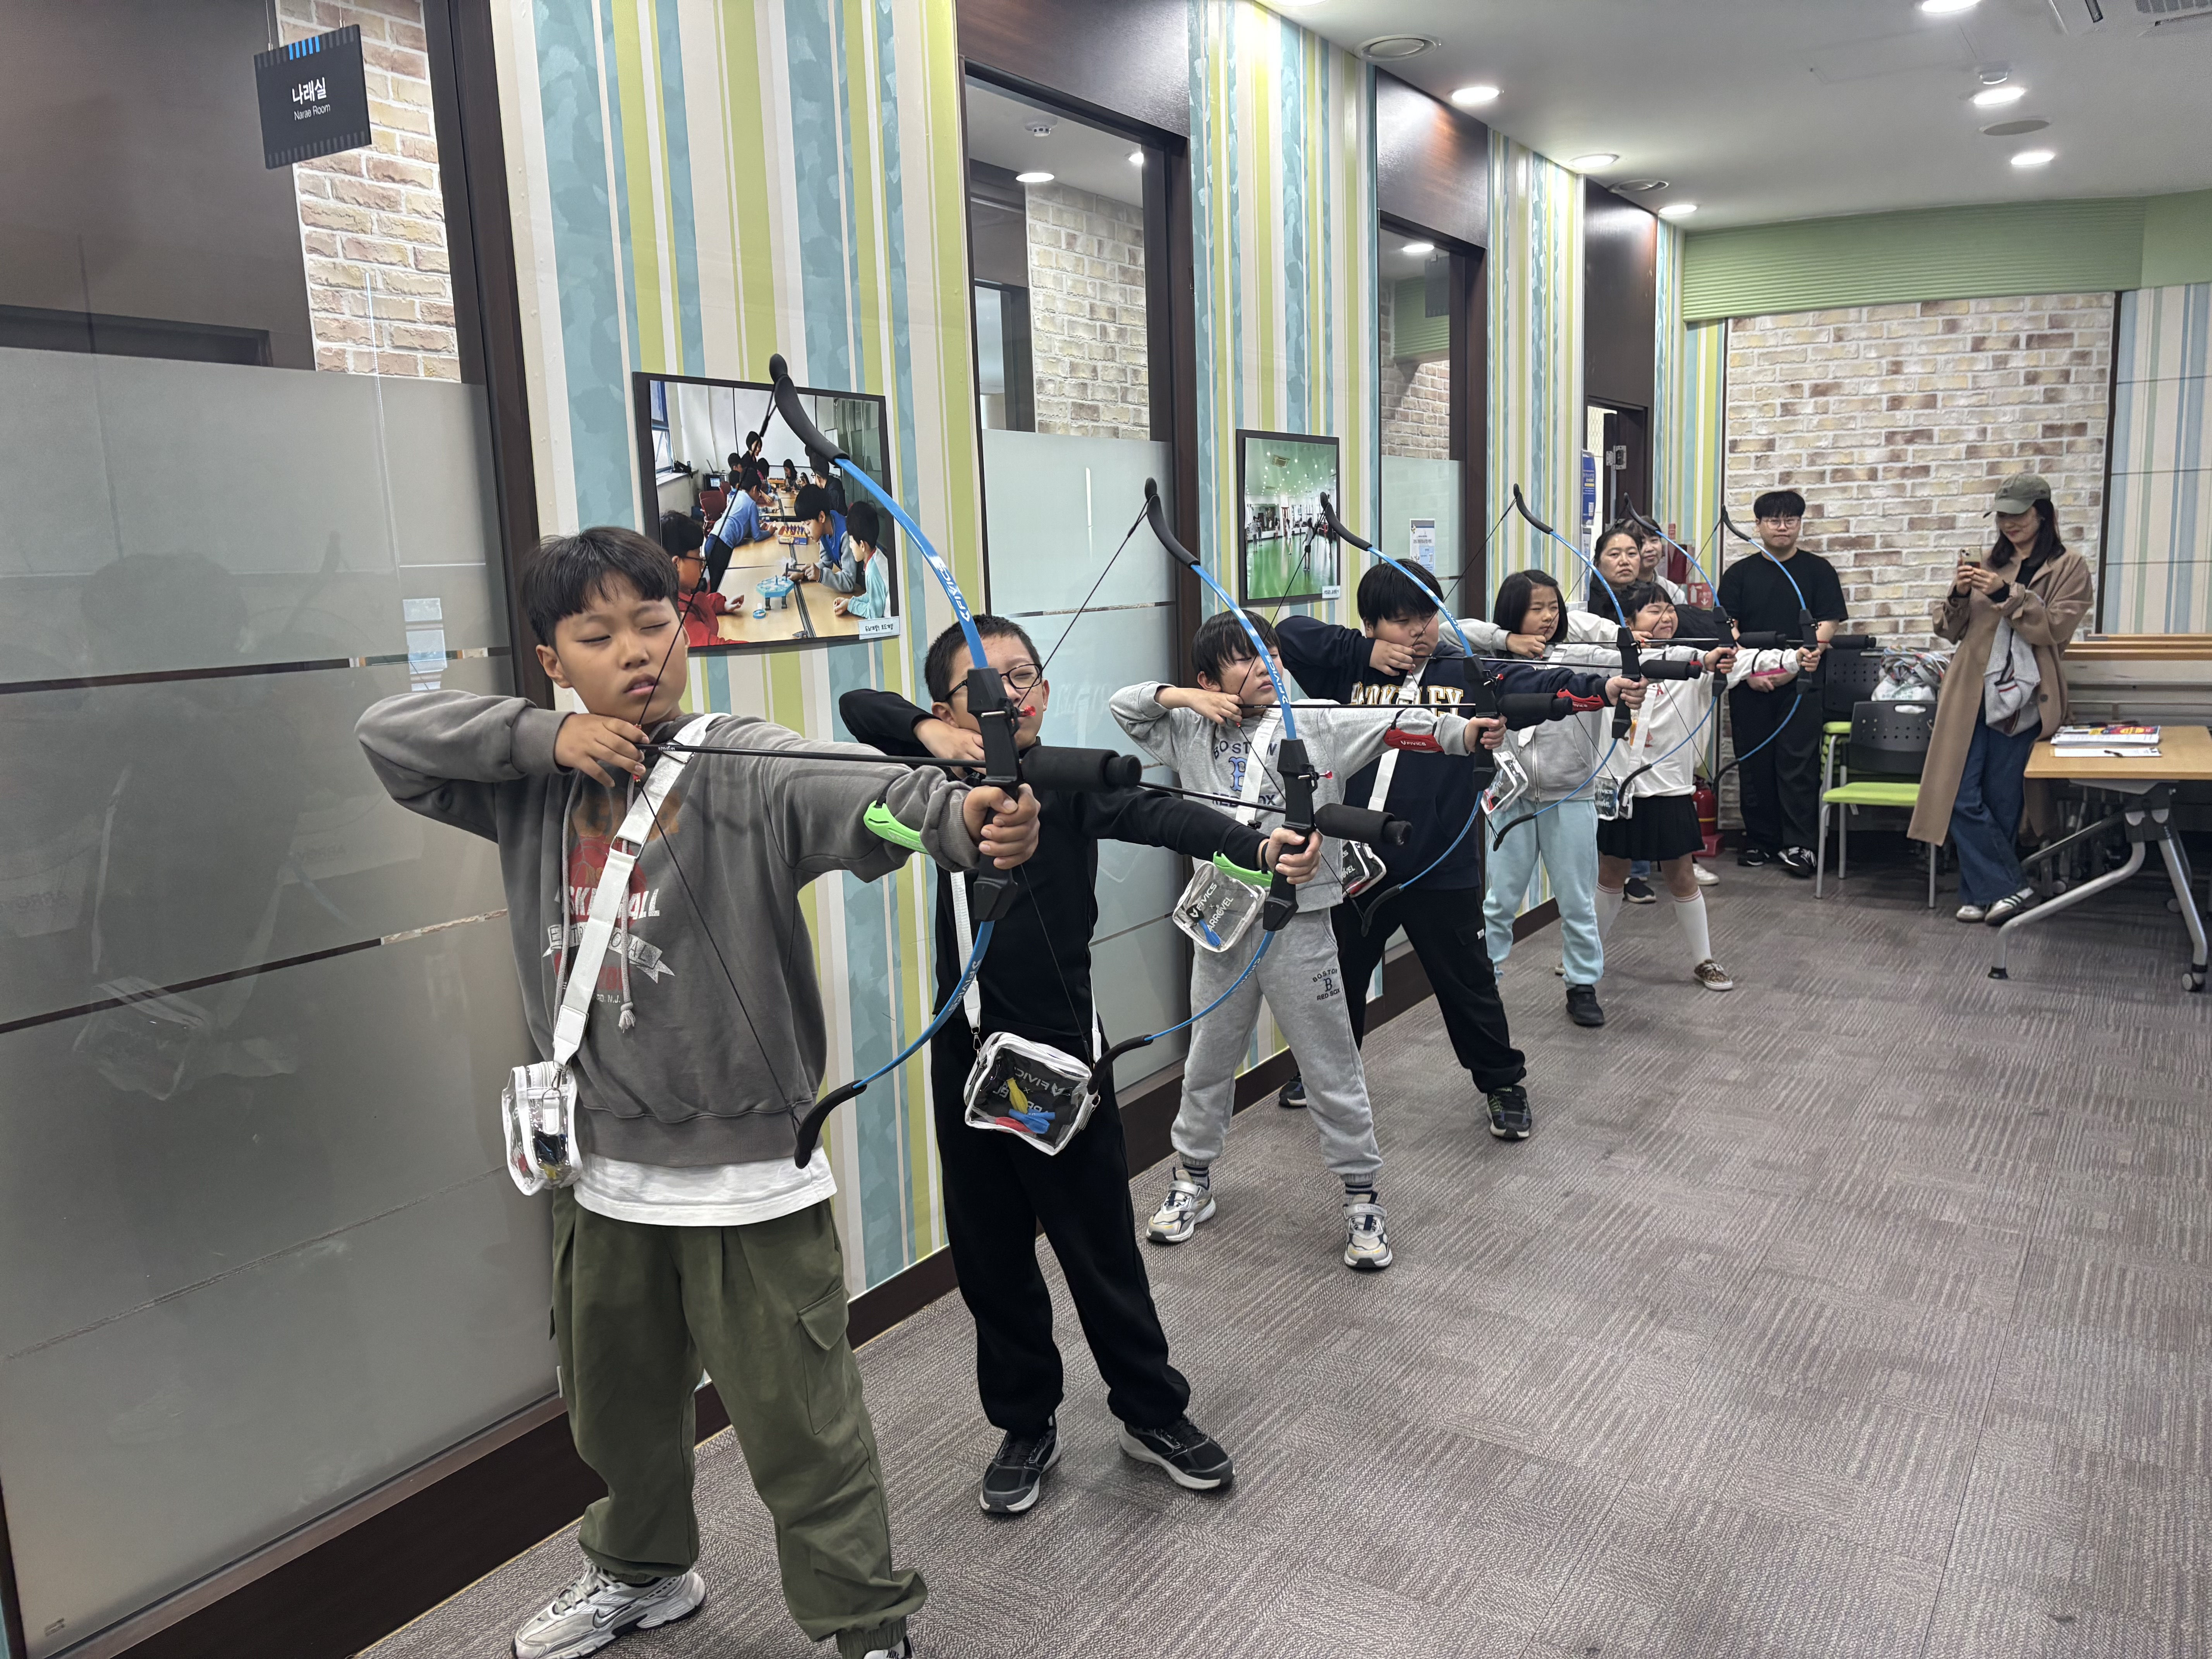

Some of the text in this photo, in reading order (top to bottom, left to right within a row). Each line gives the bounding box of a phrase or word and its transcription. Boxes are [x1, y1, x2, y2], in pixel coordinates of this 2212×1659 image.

[292, 77, 327, 105] 나래실
[294, 104, 330, 121] Narae Room
[1213, 740, 1277, 760] BOSTN
[1196, 882, 1217, 911] FIVICS
[1207, 897, 1234, 932] ARROVEL
[1317, 987, 1340, 1001] RED SOX
